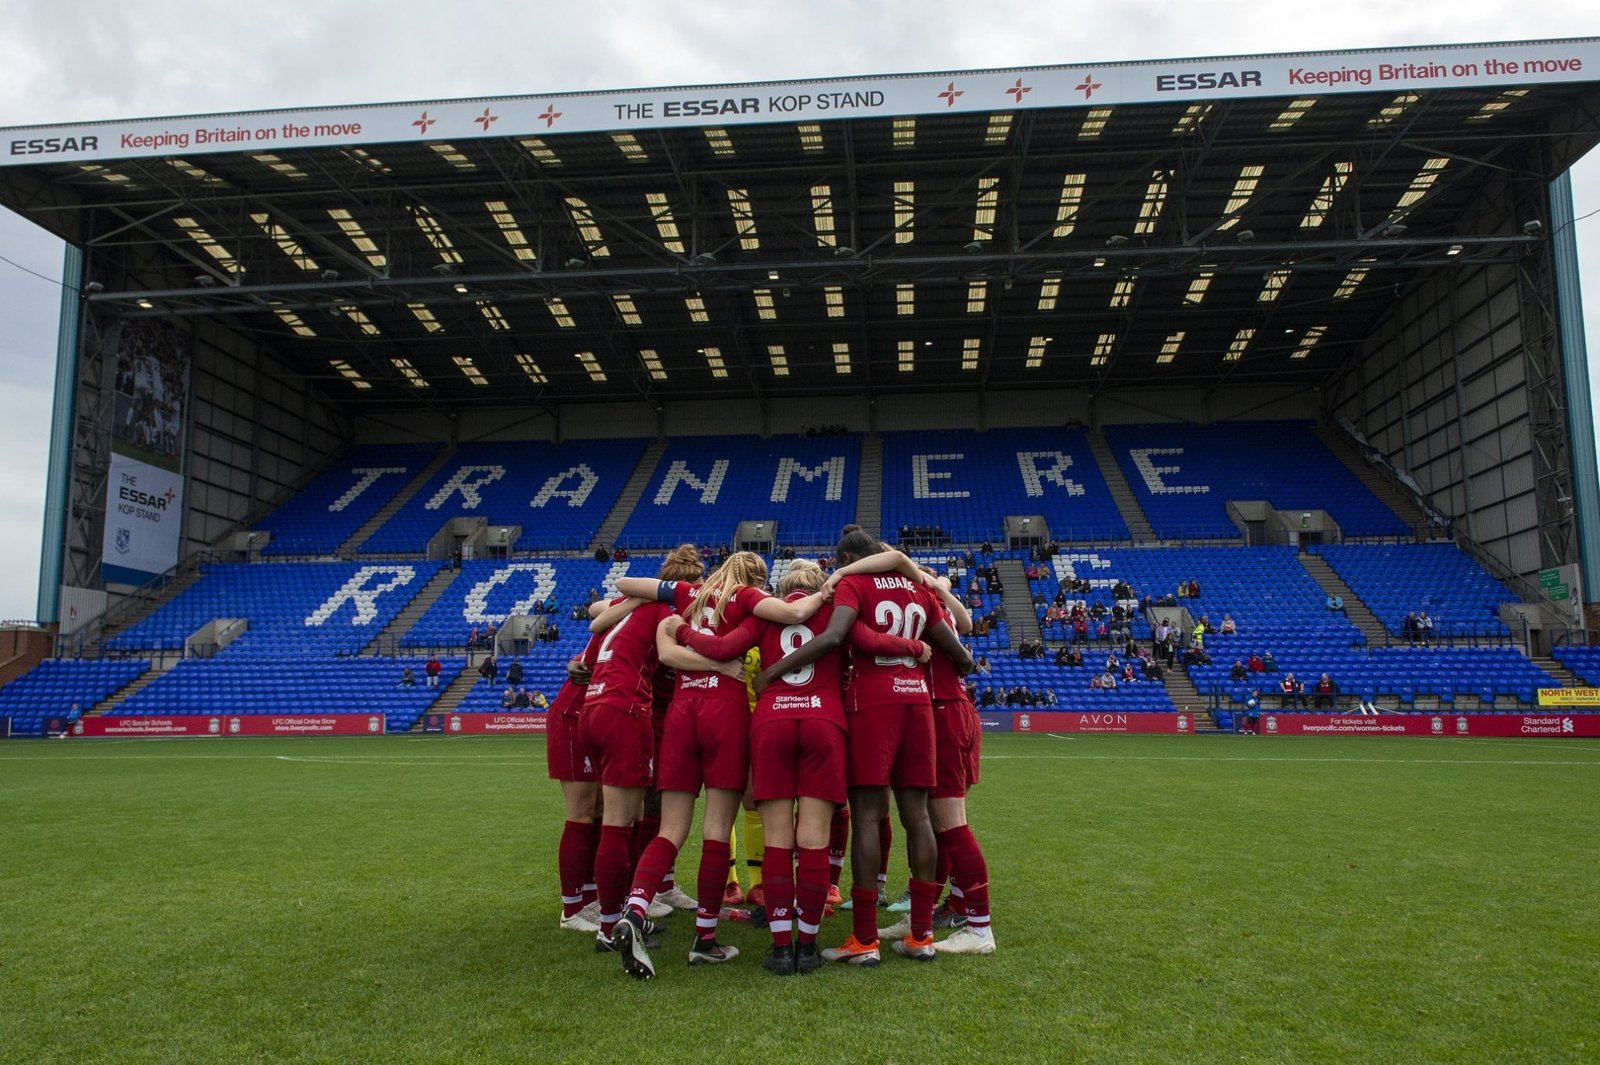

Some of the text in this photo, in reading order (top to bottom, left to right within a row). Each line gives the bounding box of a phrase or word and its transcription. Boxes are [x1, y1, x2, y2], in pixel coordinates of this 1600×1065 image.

[1156, 70, 1262, 92] ESSAR
[1289, 58, 1582, 87] Keeping Britain on the move
[614, 90, 885, 120] THE ESSAR KOP STAND
[121, 122, 362, 149] Keeping Britain on the move
[10, 136, 98, 155] ESSAR
[121, 473, 137, 486] THE
[119, 487, 166, 511] ESSAR
[118, 503, 161, 523] KOP STAND
[874, 600, 927, 669] 20
[1541, 689, 1599, 697] NORTH WEST
[772, 702, 810, 710] Chartered
[1079, 714, 1127, 725] AVON
[1303, 725, 1405, 733] liverpoolfc.com/women-tickets
[1521, 725, 1561, 733] Chartered
[1523, 717, 1560, 725] Standard
